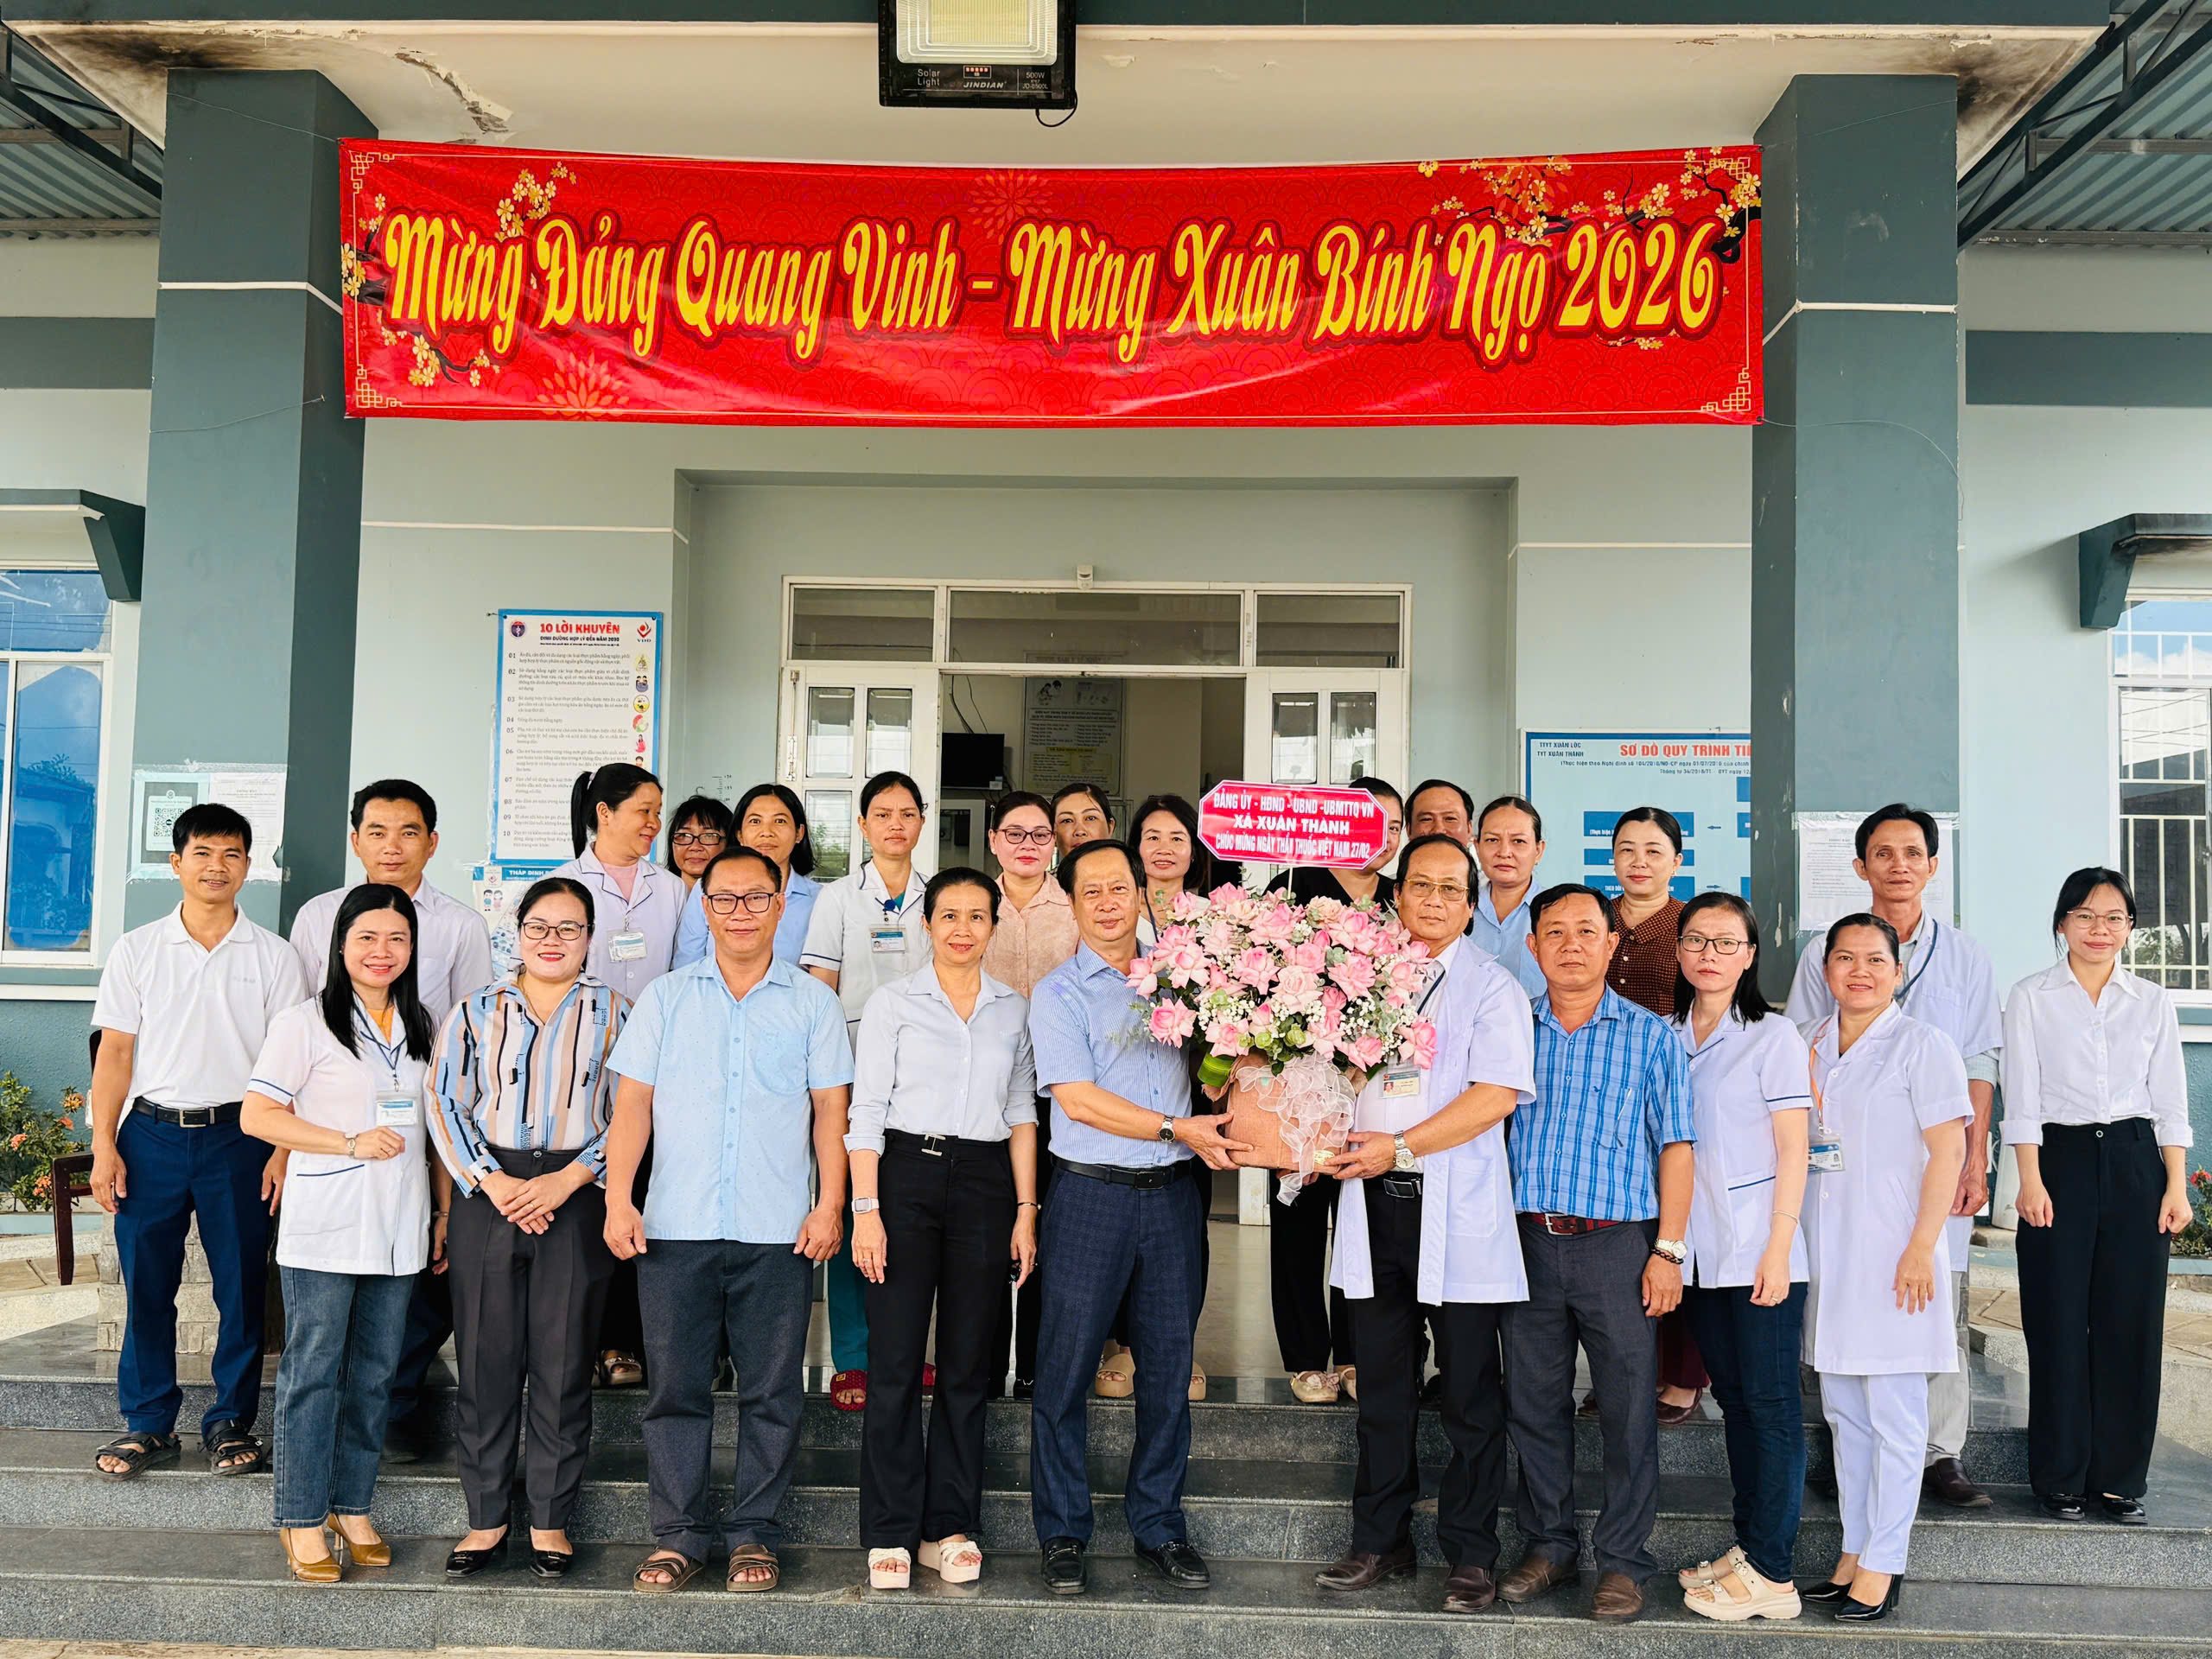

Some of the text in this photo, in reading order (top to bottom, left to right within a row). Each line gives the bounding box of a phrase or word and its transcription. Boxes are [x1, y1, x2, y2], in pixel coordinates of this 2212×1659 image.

[918, 68, 940, 77] Solar
[918, 78, 940, 87] Light
[385, 213, 523, 355] Mừng
[537, 216, 665, 357] Đảng
[677, 222, 831, 359] Quang
[843, 223, 957, 330] Vinh
[1010, 223, 1156, 363] Mừng
[1166, 225, 1300, 334] Xuân
[1313, 226, 1433, 339] Bính
[1448, 223, 1549, 360] Ngọ
[1558, 223, 1723, 329] 2026
[540, 620, 620, 634] 10 LỜI KHUYÊN
[1620, 743, 1637, 757] SƠ
[1641, 741, 1658, 757] ĐỒ
[1662, 745, 1688, 757] QUY
[1692, 743, 1730, 757] TRÌNH
[1213, 788, 1238, 809] ĐẢNG
[1240, 789, 1252, 810] ỦY
[1293, 798, 1318, 814] UBND
[1361, 802, 1375, 818] VN
[1256, 814, 1297, 831] XUÂN
[1300, 817, 1350, 835] THÀNH
[1216, 830, 1234, 849] CHÚC
[1257, 833, 1275, 853] NGÀY
[1318, 836, 1333, 859] VIỆT
[1333, 841, 1351, 857] NAM
[1351, 842, 1370, 859] 27/02
